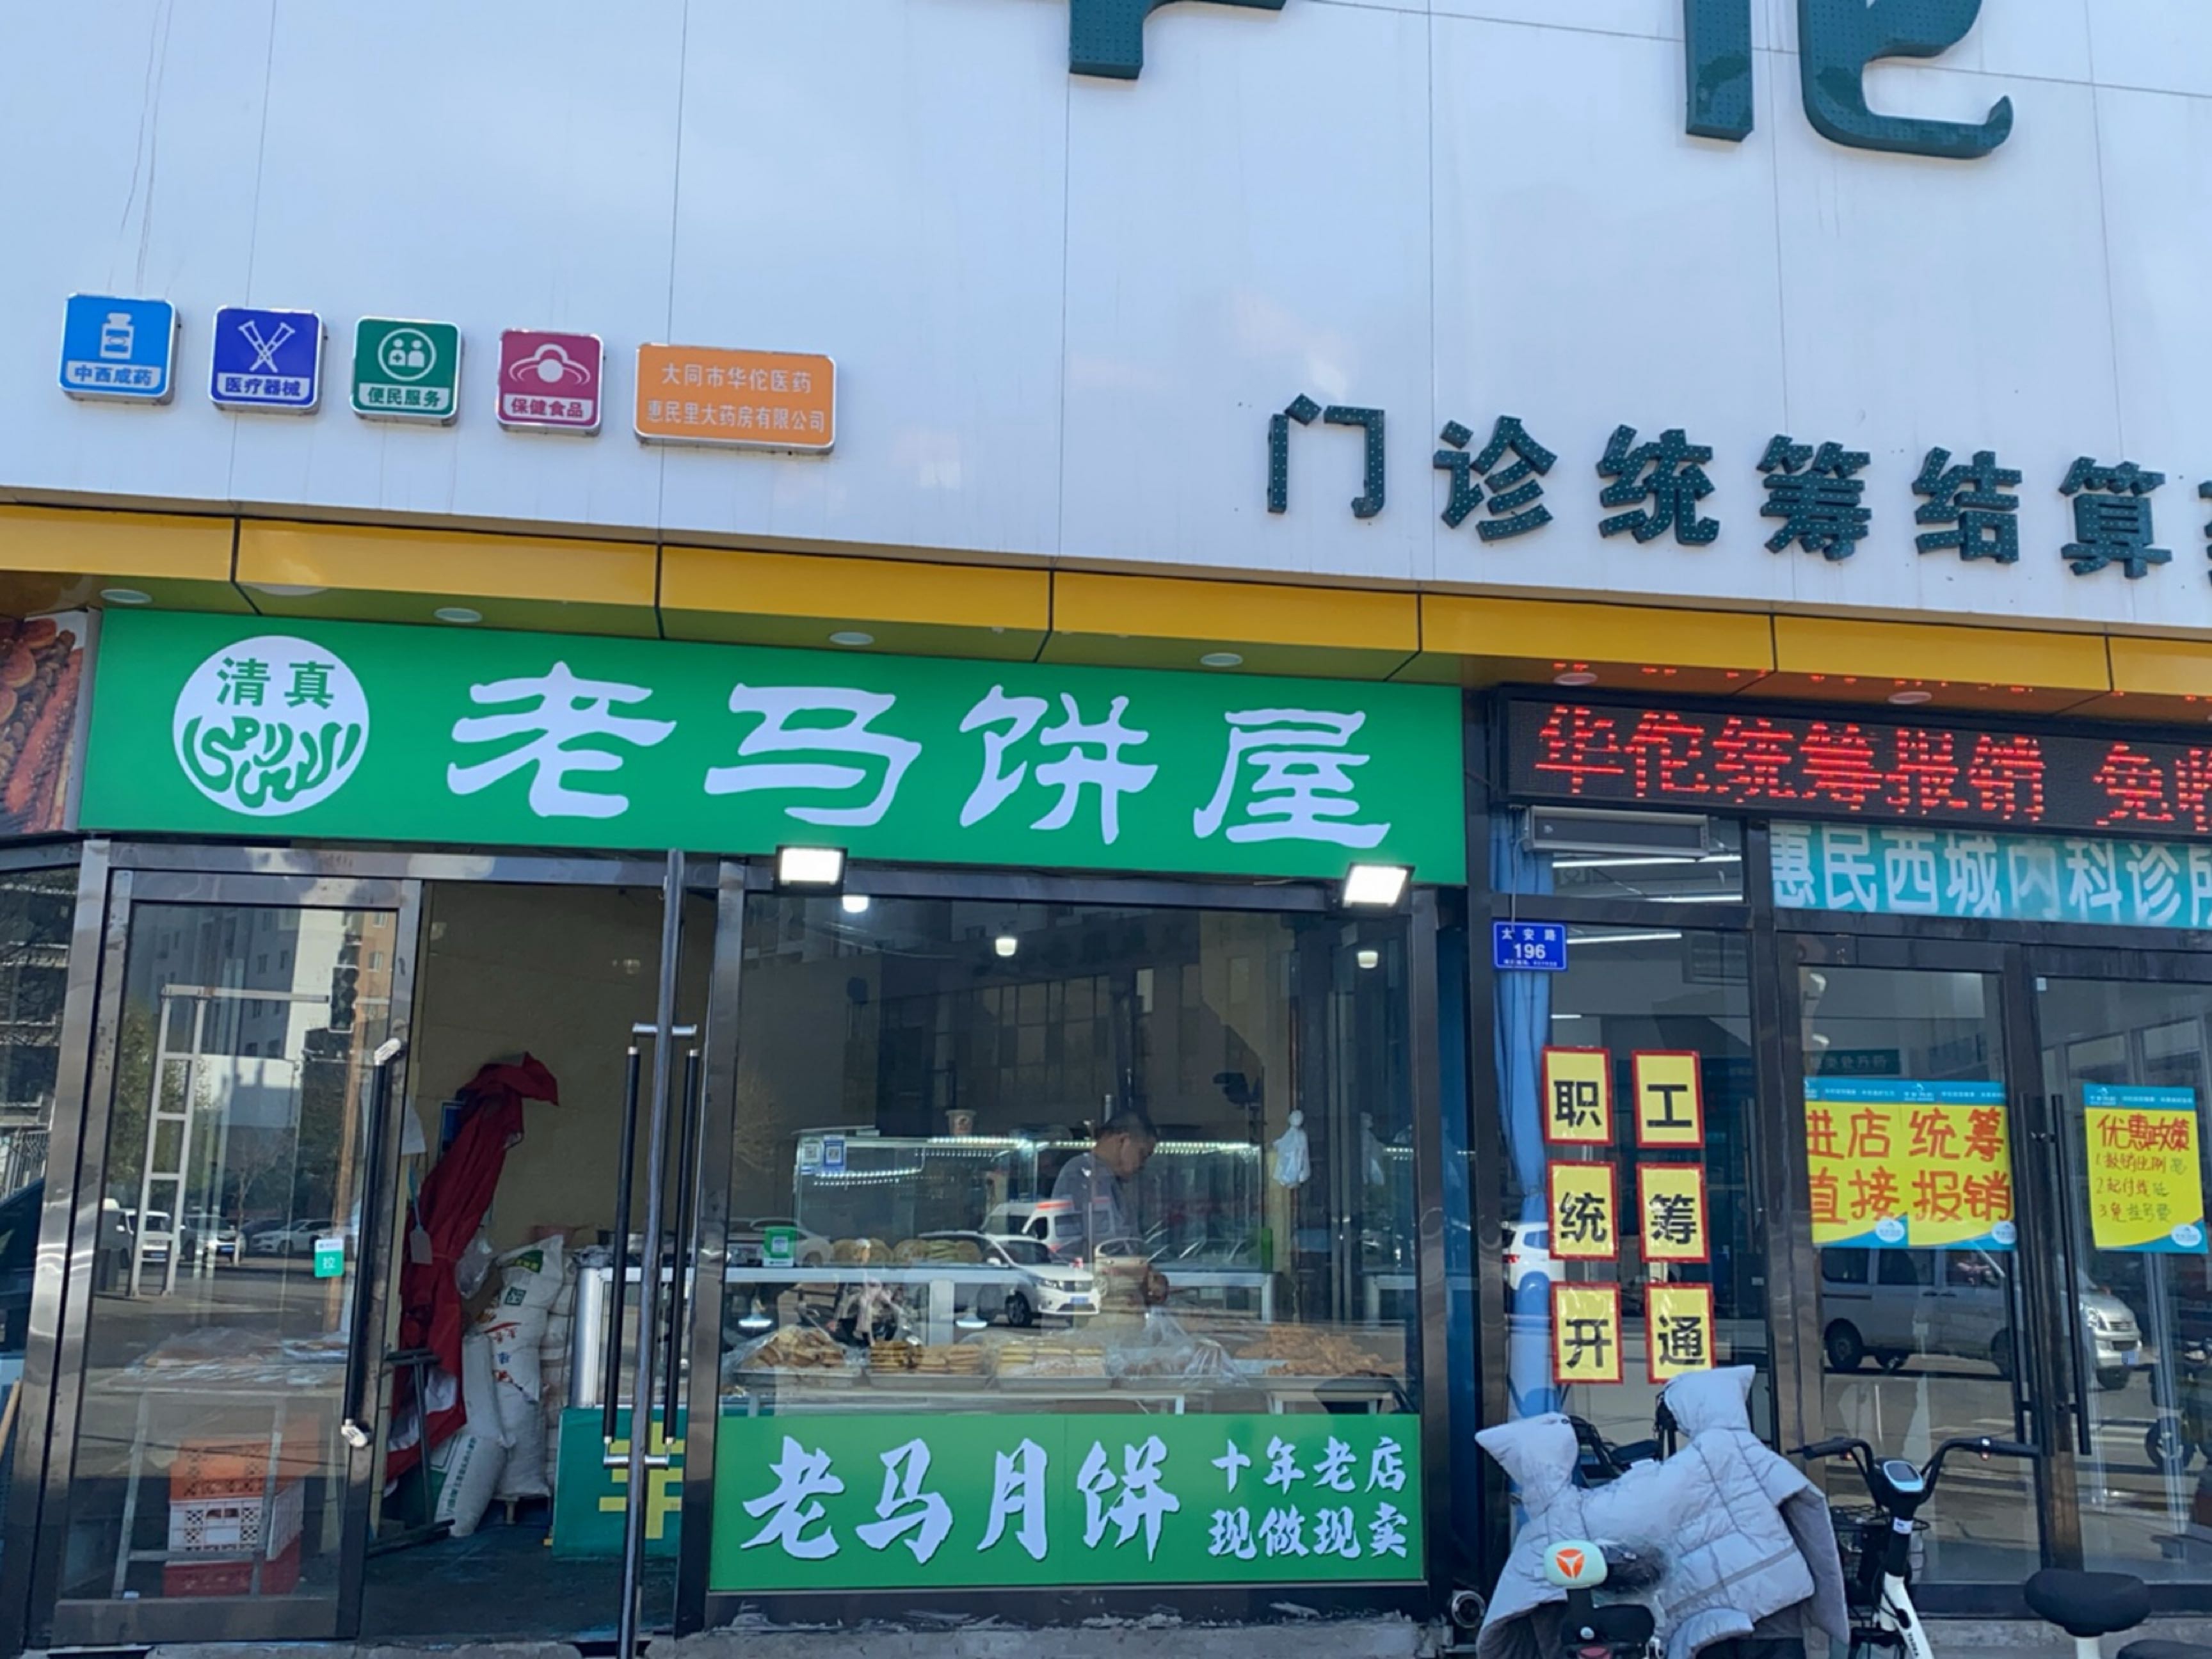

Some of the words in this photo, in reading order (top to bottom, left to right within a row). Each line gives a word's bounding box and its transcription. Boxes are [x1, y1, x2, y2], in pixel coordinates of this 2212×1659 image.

[74, 364, 152, 385] 中西成药
[225, 376, 300, 397] 医疗器械
[661, 363, 812, 394] 大同市华佗医药
[368, 387, 441, 408] 便民服务
[510, 397, 583, 417] 保健食品
[646, 399, 824, 433] 惠民里大药房有限公司
[1267, 393, 2212, 586] 门诊统筹结算
[216, 657, 336, 709] 清真
[447, 661, 1390, 849] 老马饼屋
[1514, 943, 1546, 959] 196
[2096, 1112, 2190, 1151] 优惠政策
[1809, 1165, 2013, 1226] 直接报销
[1210, 1434, 1407, 1495] 十年老店
[740, 1436, 1181, 1564] 老马月饼
[1208, 1501, 1409, 1560] 现做现卖
